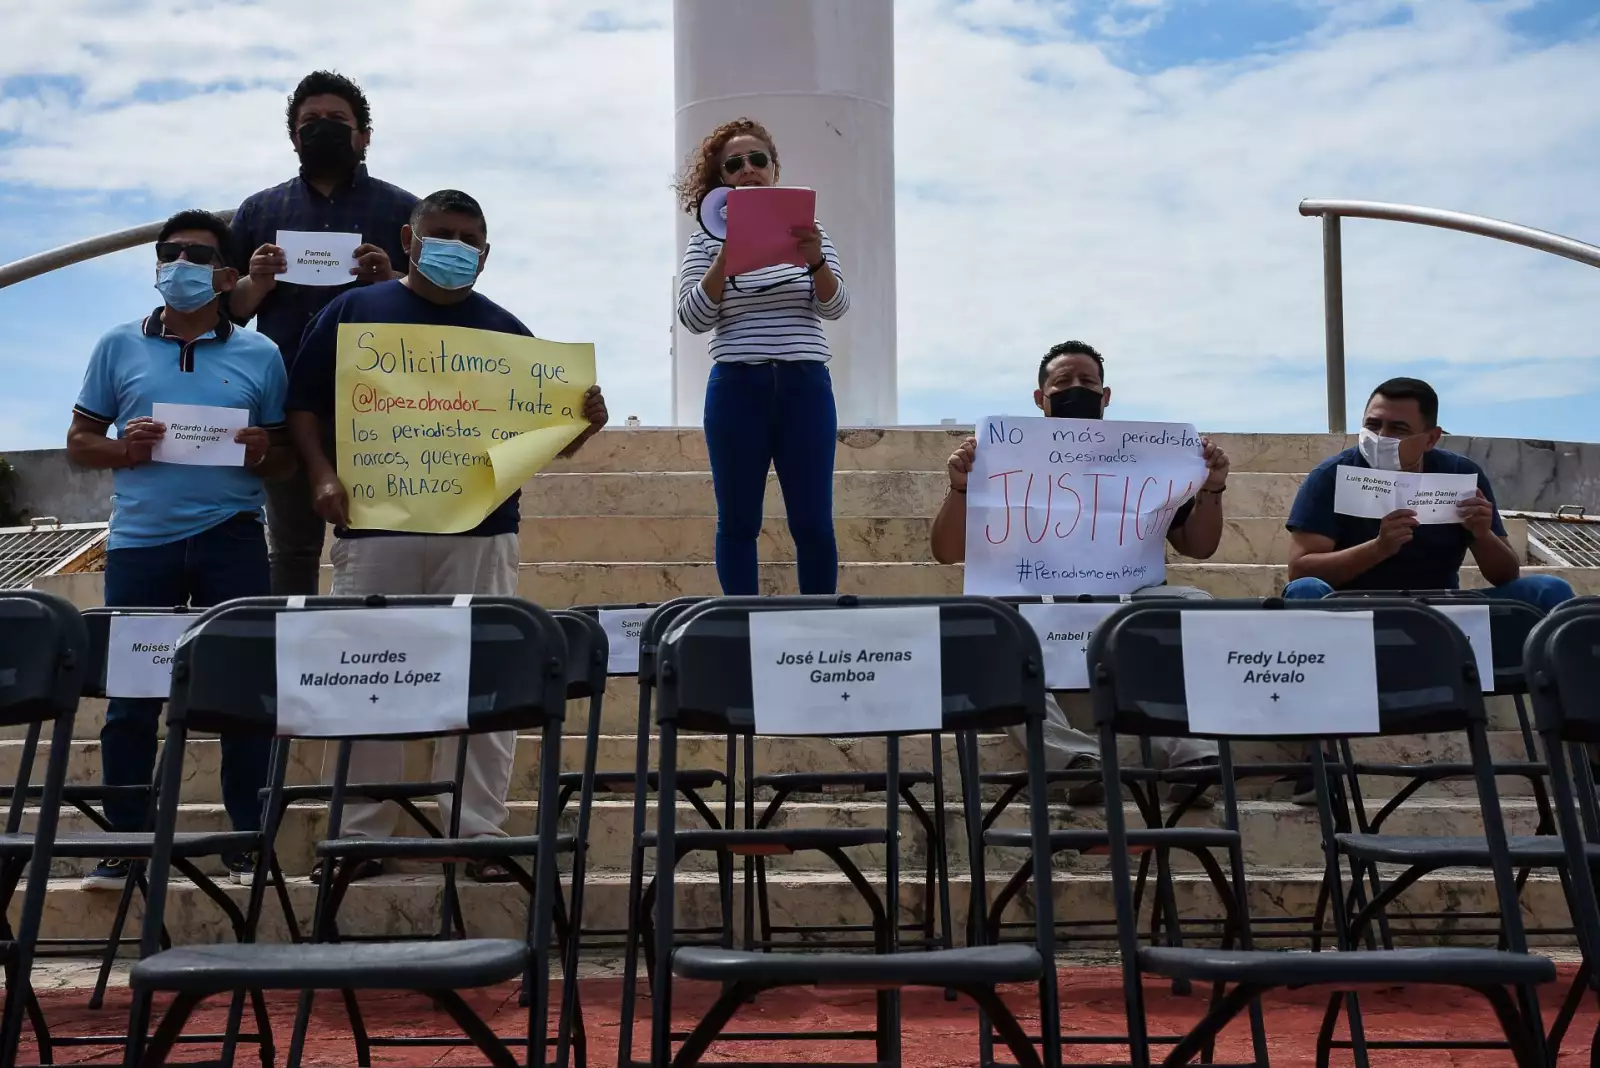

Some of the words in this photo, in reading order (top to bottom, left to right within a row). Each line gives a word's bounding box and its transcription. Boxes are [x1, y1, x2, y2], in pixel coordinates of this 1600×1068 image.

[296, 258, 340, 266] Montenegro
[355, 331, 511, 376] Solicitamos
[530, 362, 568, 388] que
[508, 388, 552, 416] trate
[561, 407, 574, 419] a
[170, 424, 202, 432] Ricardo
[352, 418, 378, 442] los
[392, 419, 482, 443] periodistas
[491, 428, 524, 440] com
[1052, 426, 1106, 444] más
[1122, 429, 1202, 448] periodistas
[1048, 449, 1138, 464] asesinados
[352, 482, 375, 498] no
[387, 473, 464, 497] BALAZOS
[1362, 476, 1392, 487] Roberto
[1046, 631, 1084, 640] Anabel
[132, 642, 170, 652] Moisés
[340, 650, 407, 664] Lourdes
[776, 651, 814, 665] José
[818, 650, 852, 664] Luis
[856, 650, 912, 663] Arenas
[1227, 651, 1272, 668] Fredy
[1276, 651, 1326, 666] López
[300, 672, 389, 686] Maldonado
[394, 670, 442, 687] López
[810, 669, 876, 684] Gamboa
[1243, 670, 1305, 684] Arévalo
